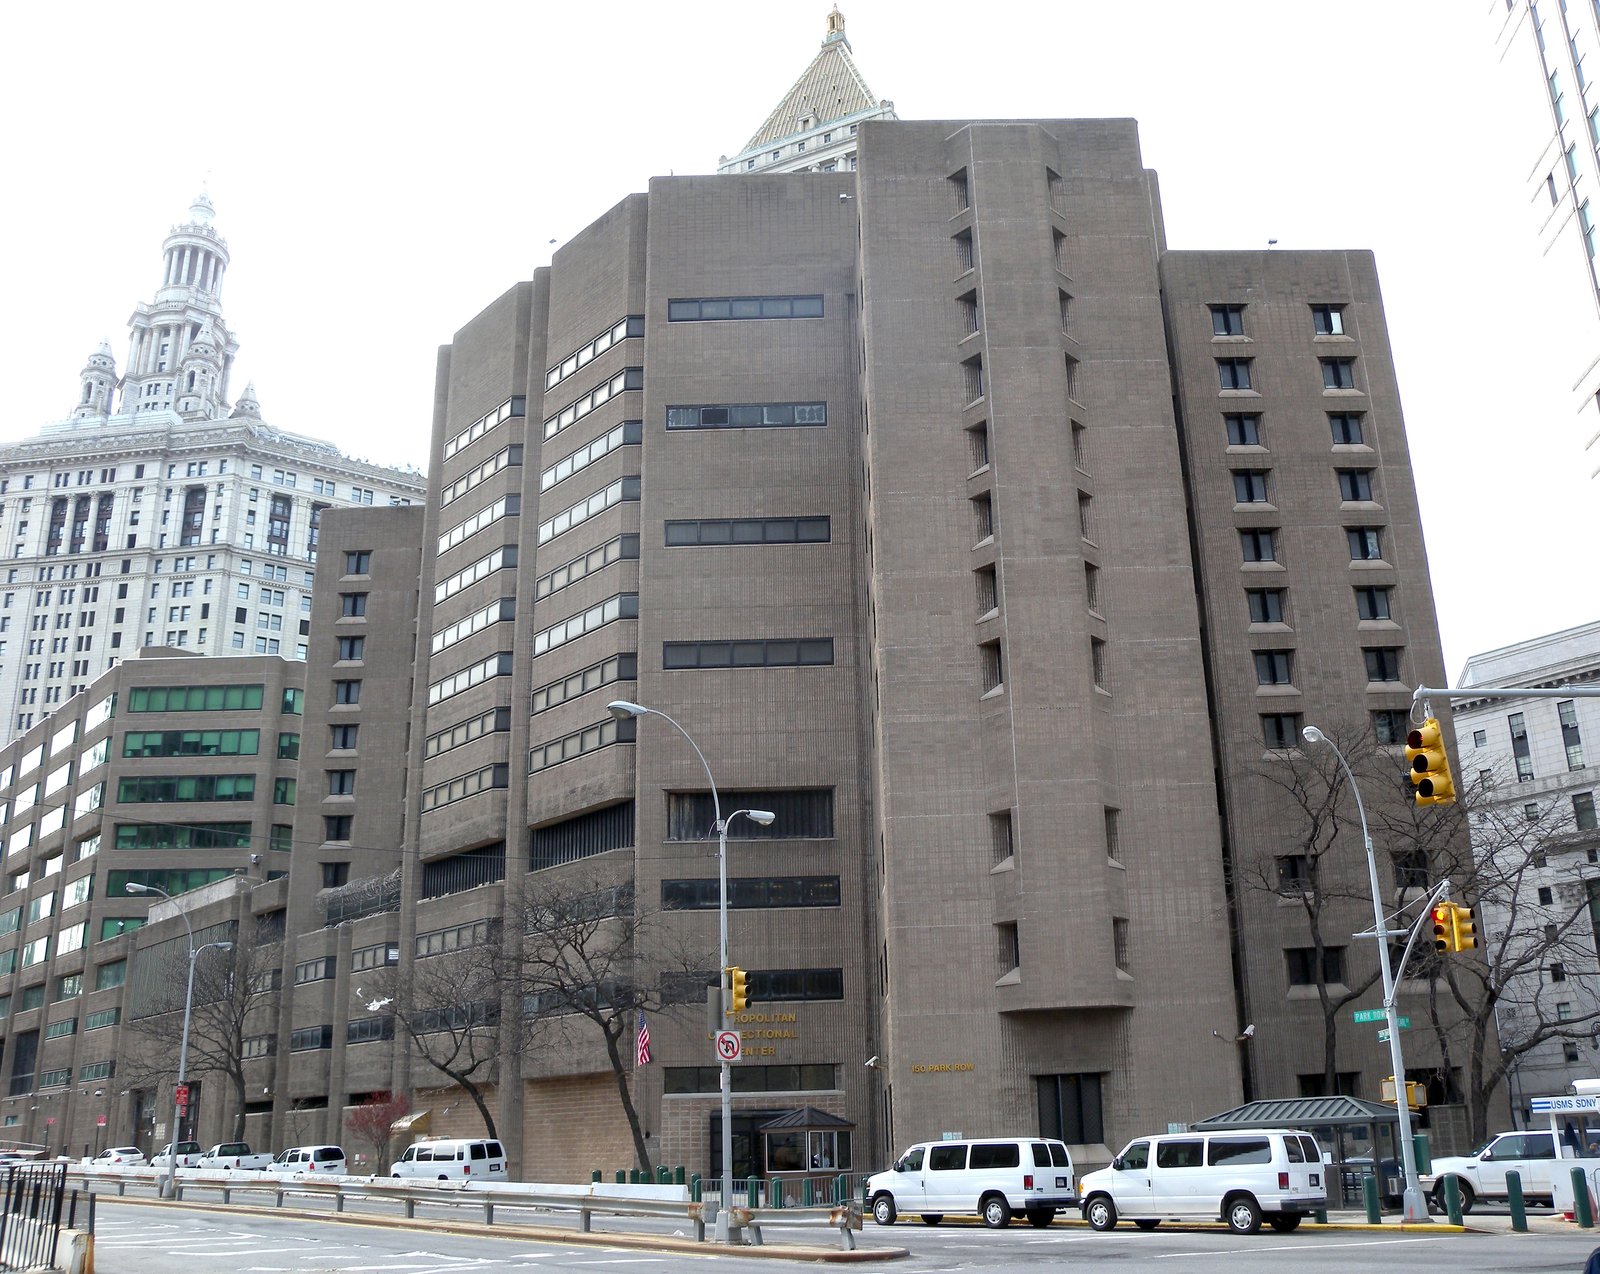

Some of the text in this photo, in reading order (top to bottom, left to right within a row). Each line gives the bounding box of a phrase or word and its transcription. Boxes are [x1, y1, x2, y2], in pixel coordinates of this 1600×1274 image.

[1355, 1012, 1370, 1021] PARK
[741, 1047, 776, 1056] ENTER
[912, 1063, 974, 1073] 150 PARK ROW
[1551, 1099, 1596, 1110] USMS SDNY
